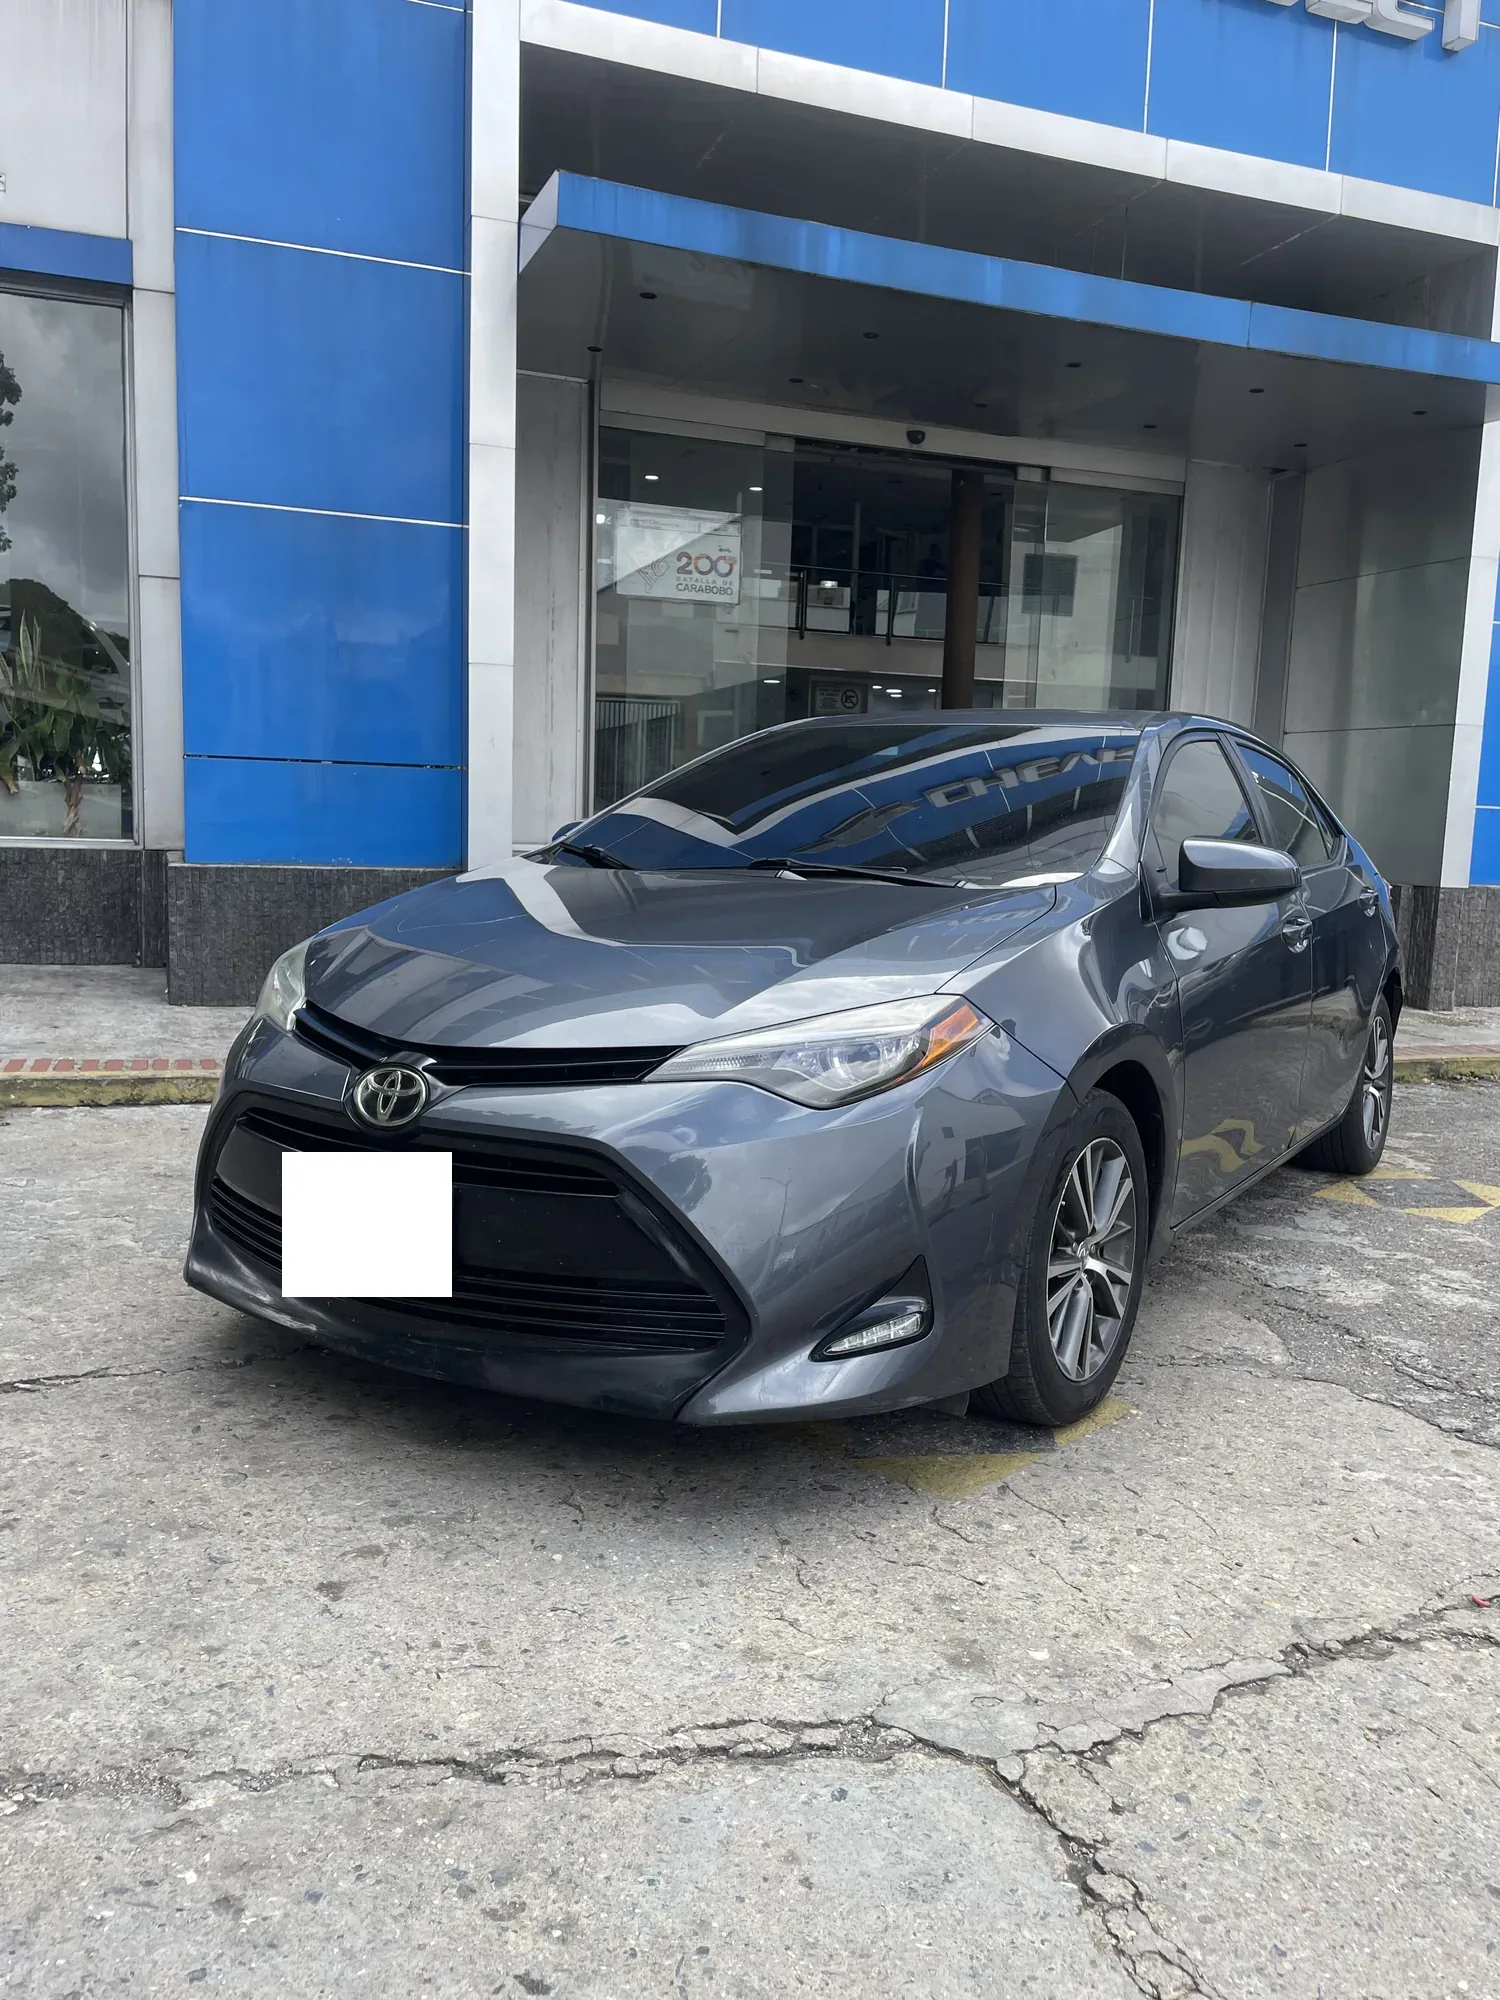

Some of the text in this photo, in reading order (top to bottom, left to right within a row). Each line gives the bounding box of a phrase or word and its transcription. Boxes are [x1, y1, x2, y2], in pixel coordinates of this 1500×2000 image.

[676, 551, 734, 578] 200
[676, 576, 717, 585] BATALLA
[676, 583, 734, 596] CARABOBO
